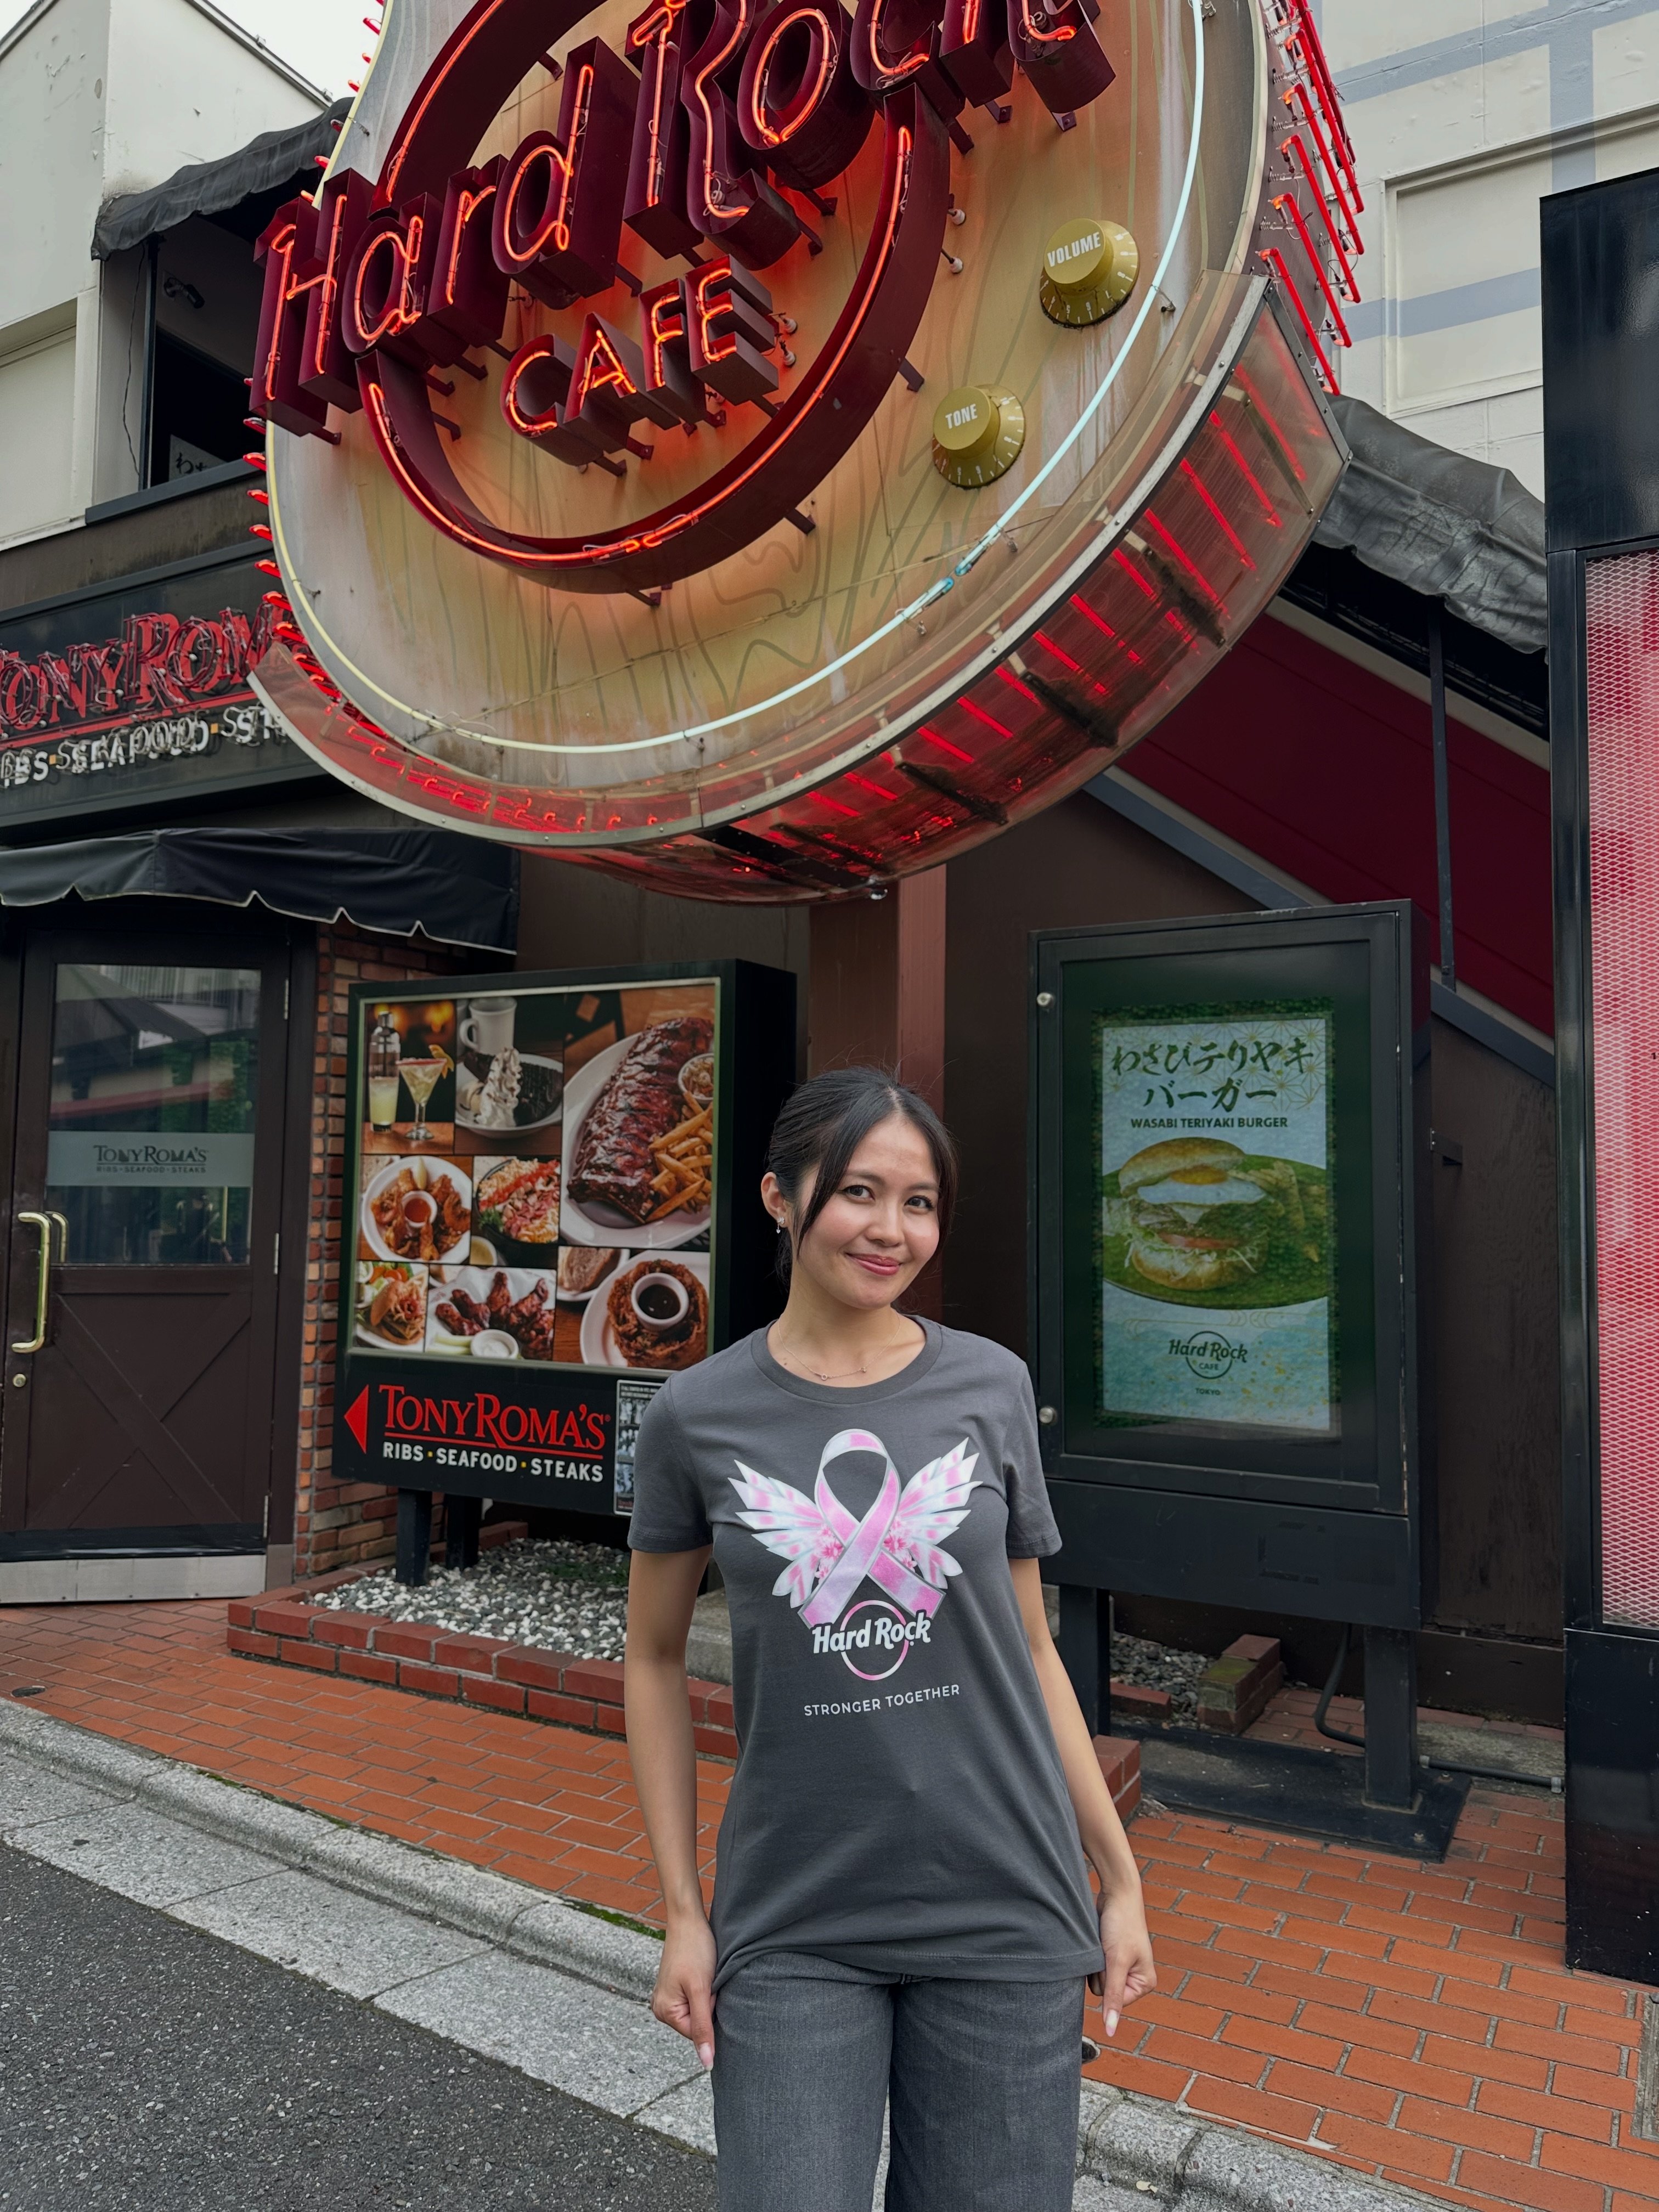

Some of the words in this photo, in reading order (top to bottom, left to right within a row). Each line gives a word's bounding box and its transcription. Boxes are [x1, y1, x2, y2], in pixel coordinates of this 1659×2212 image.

[251, 35, 636, 432] Hard
[624, 0, 1116, 270] Roc
[1047, 232, 1101, 268] VOLUME
[501, 255, 779, 462] CAFE
[945, 404, 978, 430] TONE
[1111, 1037, 1313, 1076] わさびテリヤキ
[1143, 1077, 1277, 1112] バーガー
[1131, 1118, 1177, 1128] WASABI
[1181, 1118, 1234, 1128] TERIYAKI
[1238, 1117, 1288, 1128] BURGER
[1169, 1339, 1207, 1357] Hard
[1210, 1342, 1248, 1363] Rock
[1195, 1387, 1221, 1396] TOKYO
[383, 1441, 424, 1462] RIBS
[436, 1448, 517, 1472] SEAFOOD
[531, 1458, 603, 1482] STEAKS
[812, 1620, 871, 1654] Hard
[874, 1612, 931, 1649] Rock
[804, 1699, 881, 1717] STRONGER
[885, 1684, 961, 1707] TOGETHER
